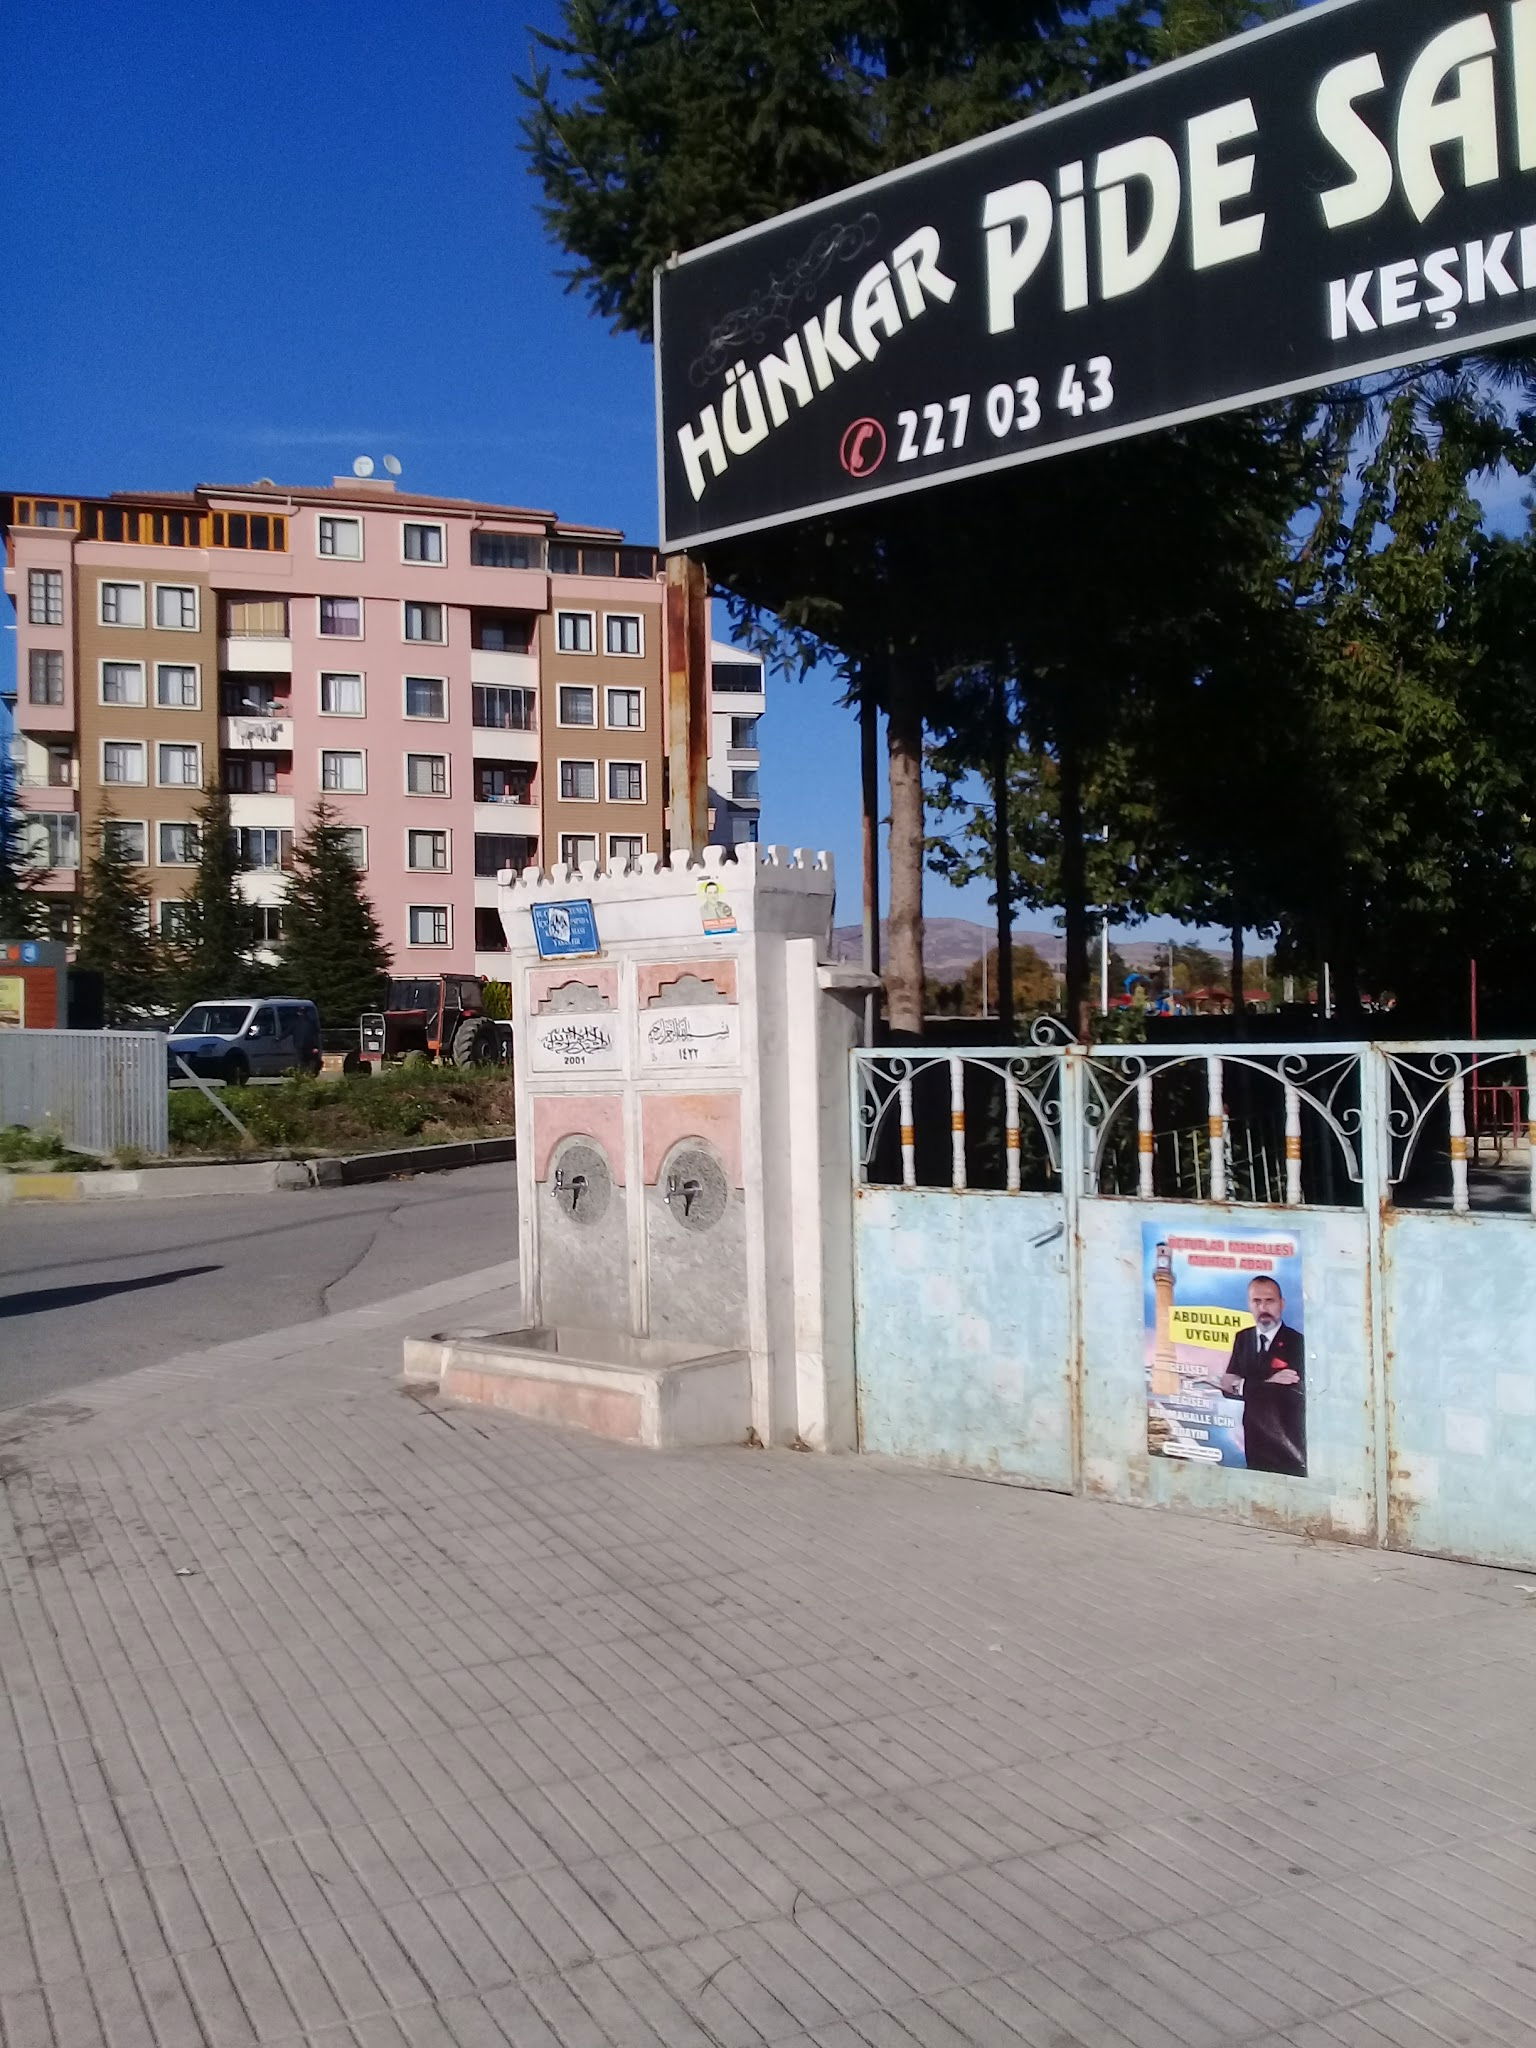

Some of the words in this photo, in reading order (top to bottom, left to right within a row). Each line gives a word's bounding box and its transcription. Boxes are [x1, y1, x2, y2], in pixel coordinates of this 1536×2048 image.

[677, 225, 957, 502] HÜNKAR
[983, 97, 1265, 334] PİDE
[897, 393, 971, 463] 227
[986, 376, 1042, 438] 03
[1057, 355, 1114, 417] 43
[563, 1056, 585, 1065] 2001
[1173, 1311, 1241, 1327] ABDULLAH
[1185, 1328, 1230, 1343] UYGUN
